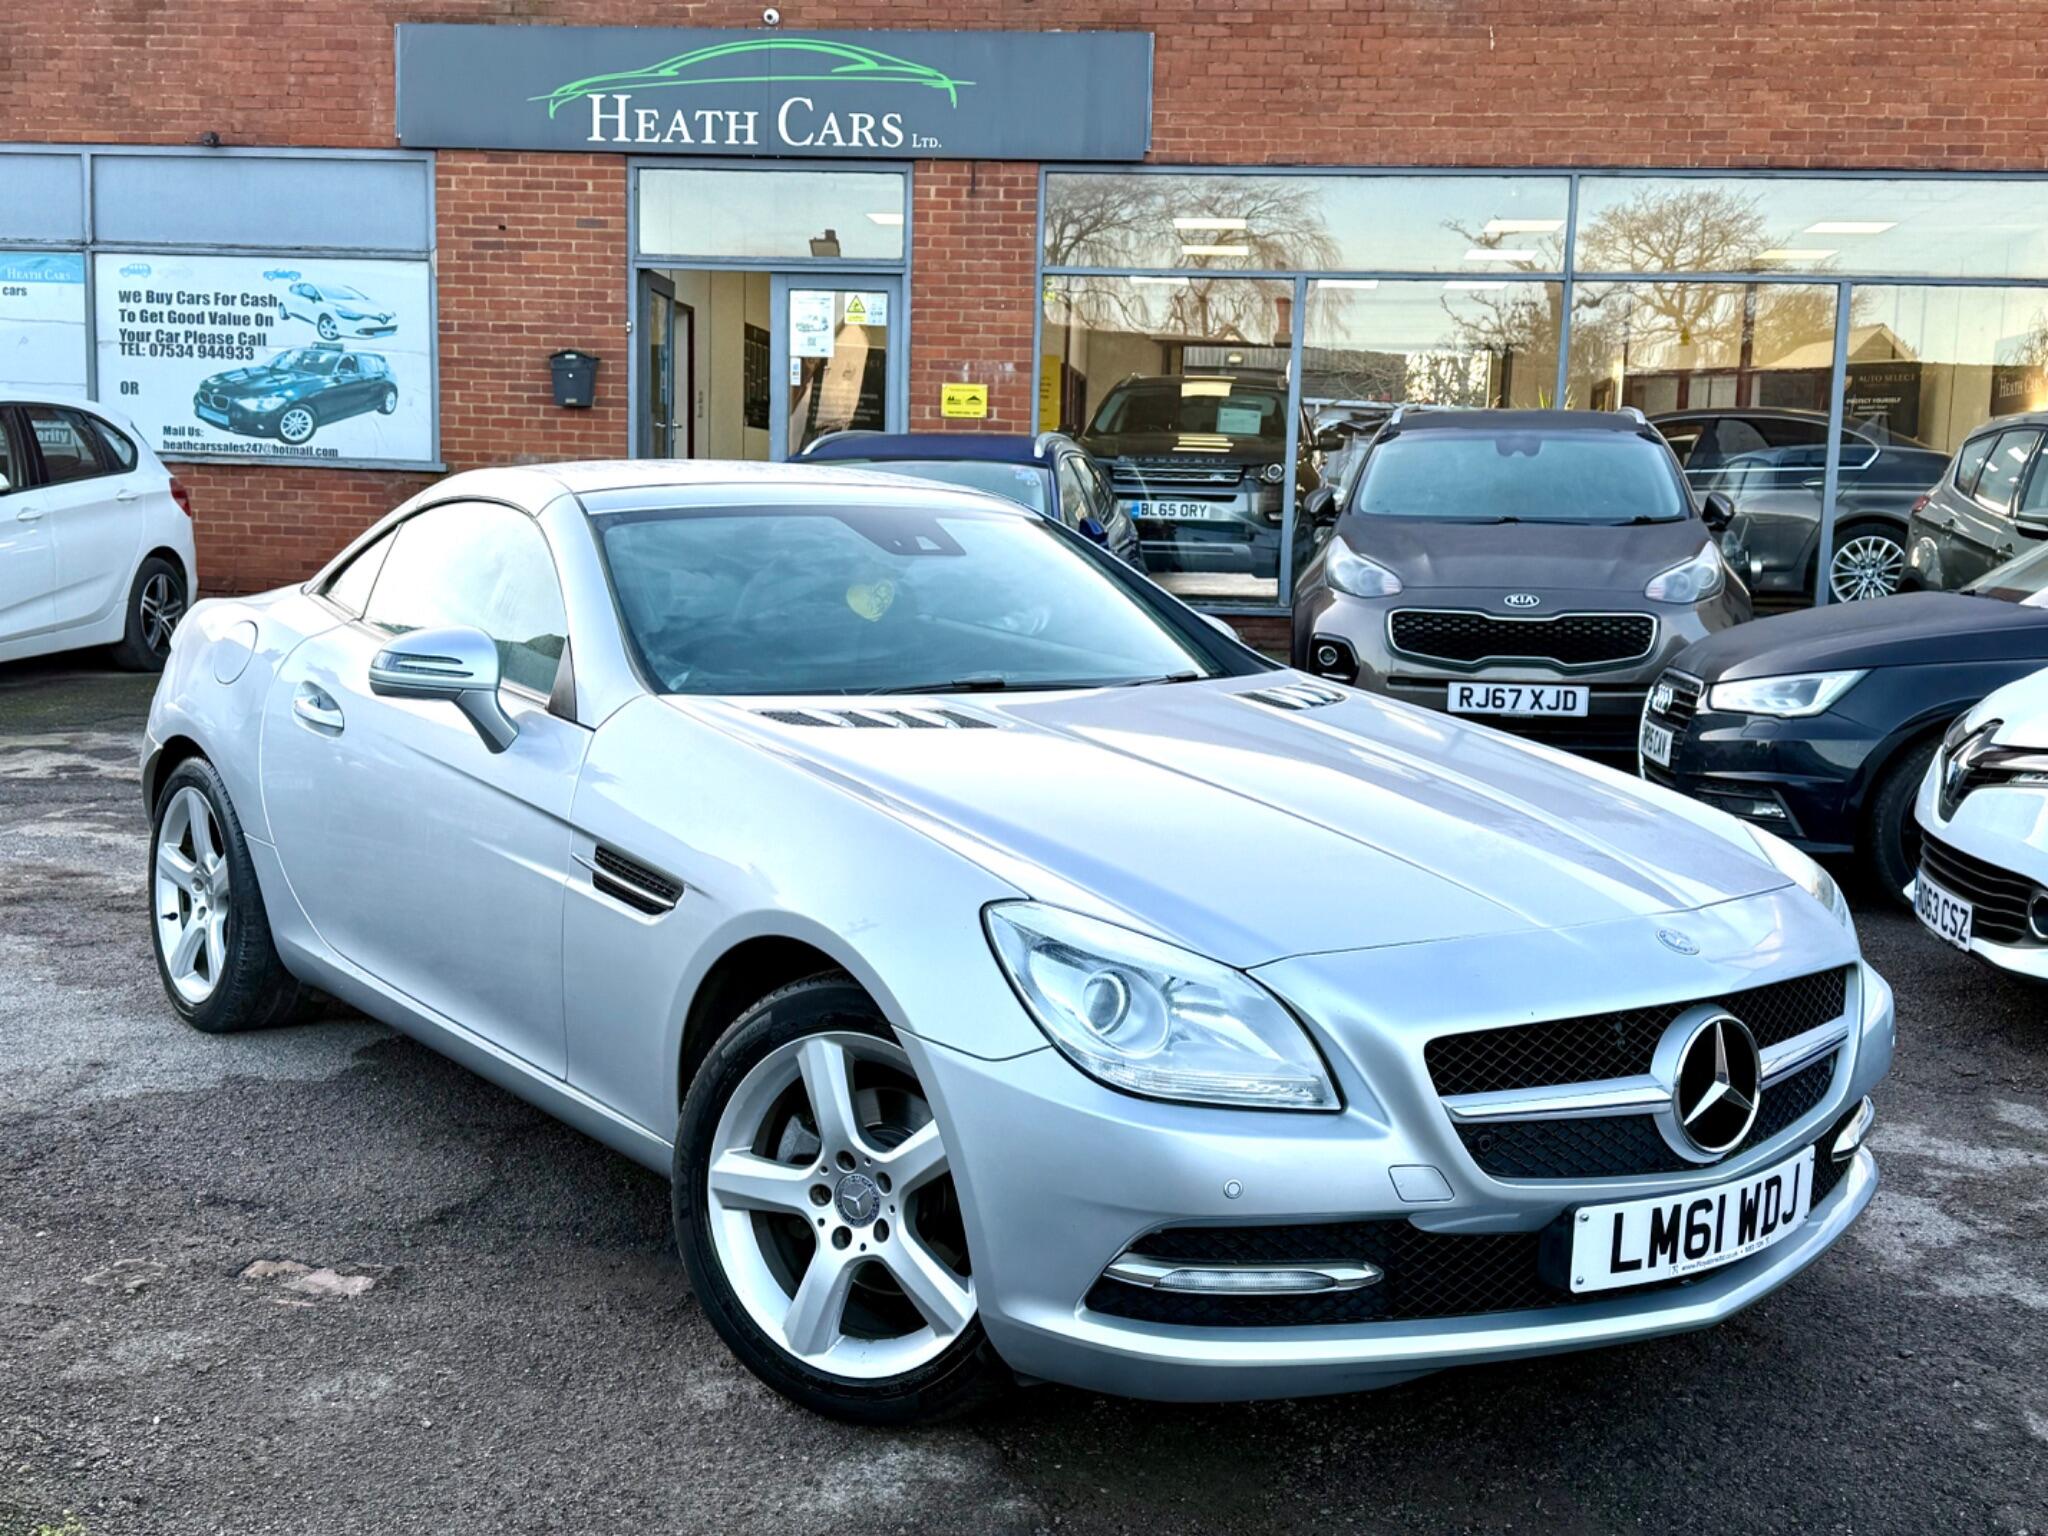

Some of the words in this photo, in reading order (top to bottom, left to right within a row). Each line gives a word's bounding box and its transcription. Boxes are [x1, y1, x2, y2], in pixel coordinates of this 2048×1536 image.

[586, 94, 759, 146] HEATH
[777, 97, 904, 148] CARS
[2, 286, 28, 296] cars
[145, 290, 173, 306] Buy
[176, 291, 211, 306] Cars
[213, 292, 237, 306] For
[240, 293, 278, 308] Cash
[118, 309, 136, 323] To
[139, 309, 164, 324] Get
[167, 310, 205, 325] Good
[208, 311, 251, 326] Value
[254, 313, 274, 327] On
[118, 328, 151, 343] Your
[155, 329, 180, 344] Car
[184, 330, 234, 346] Please
[237, 332, 267, 346] Call
[118, 342, 146, 357] TEL:
[148, 343, 194, 358] 07534
[197, 345, 255, 361] 944933
[120, 380, 140, 395] OR
[162, 425, 185, 437] Mail
[188, 426, 204, 437] Us:
[162, 440, 338, 458] heathcarssales247@hotmail.com
[1141, 502, 1177, 517] BL65
[1459, 687, 1523, 709] RJ67
[1529, 689, 1577, 711] XJD
[1941, 898, 1970, 944] CSZ
[1610, 1194, 1727, 1274] LM61
[1738, 1163, 1801, 1247] WDJ
